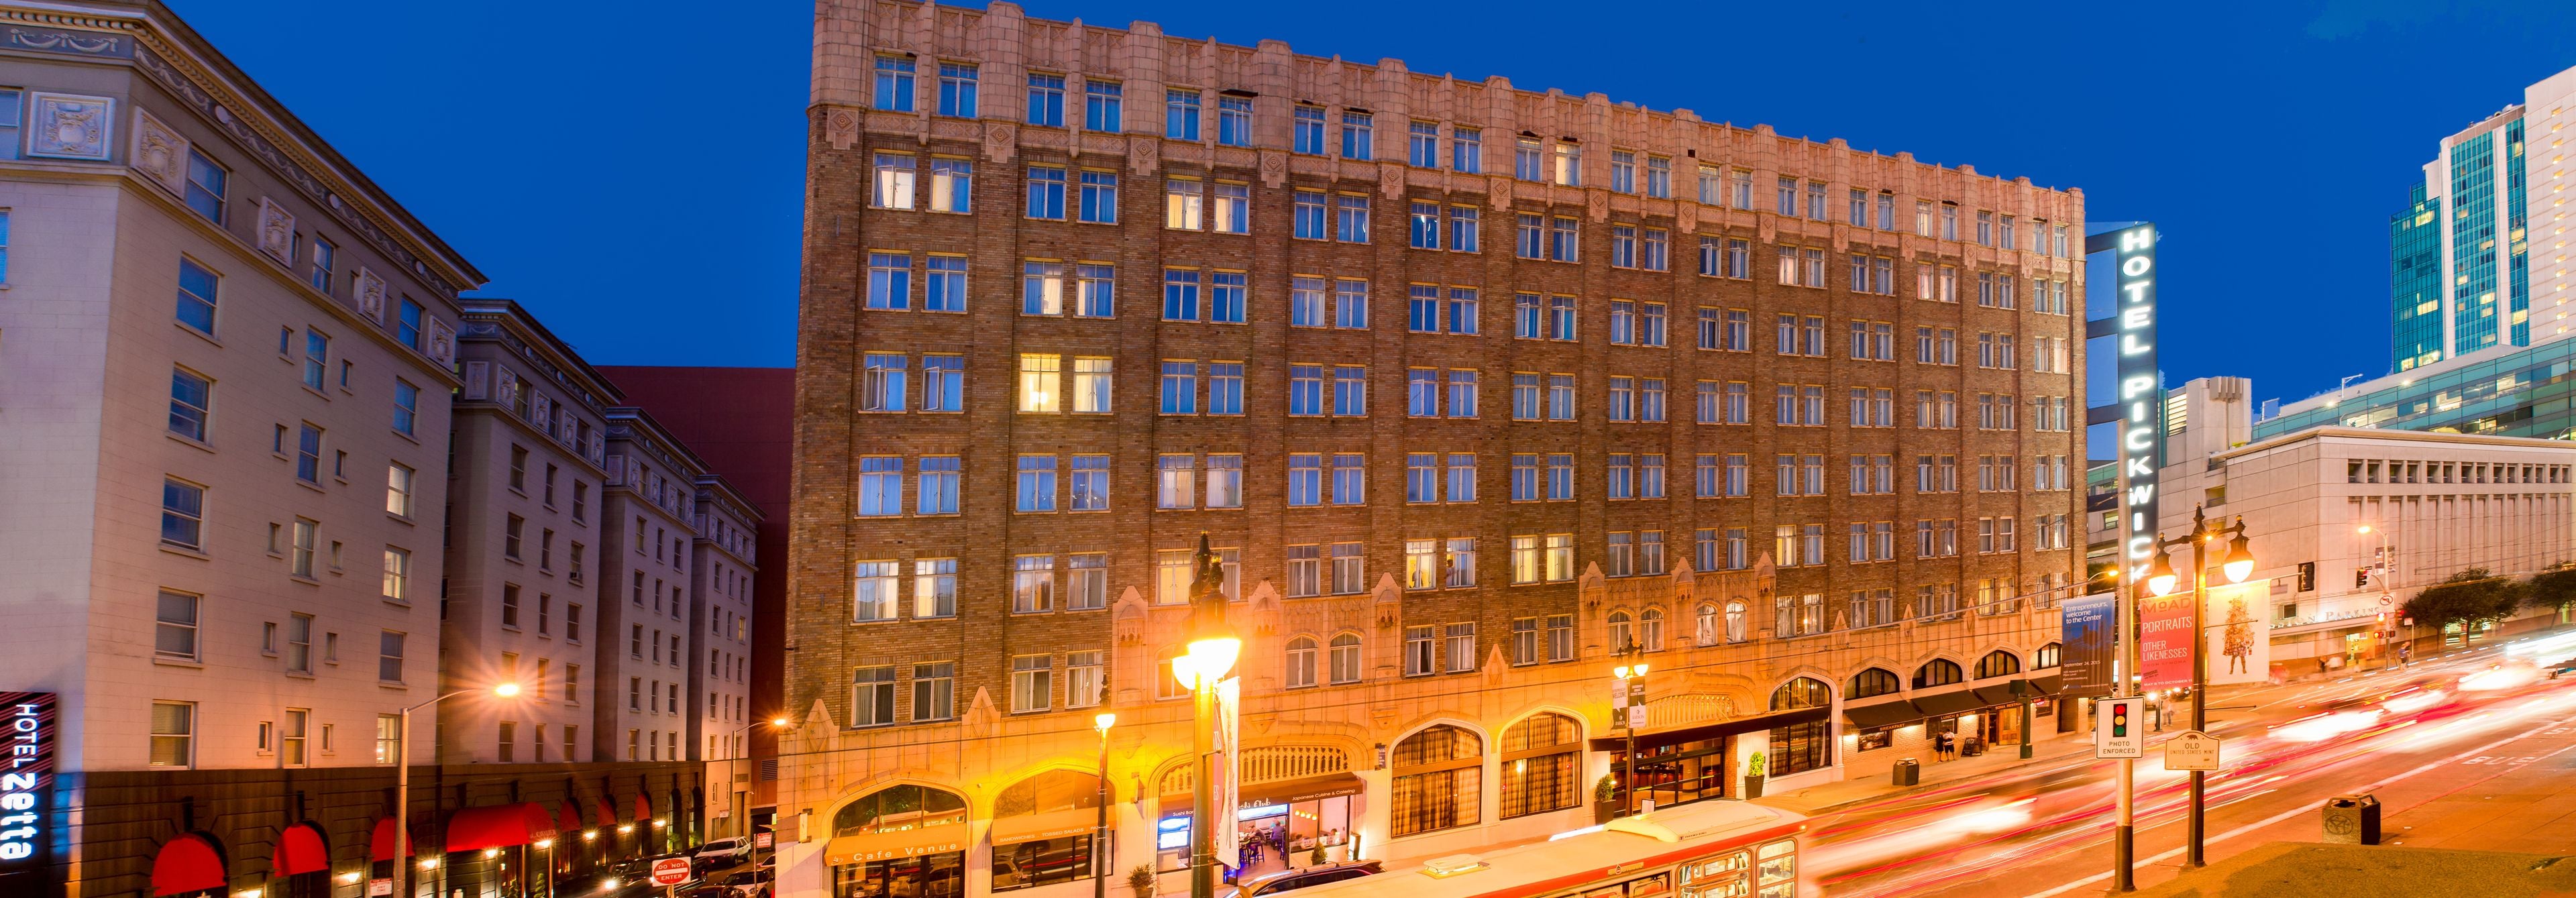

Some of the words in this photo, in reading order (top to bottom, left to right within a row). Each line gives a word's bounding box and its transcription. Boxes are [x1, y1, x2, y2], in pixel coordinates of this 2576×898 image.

[2123, 229, 2151, 355] HOTEL
[2125, 376, 2154, 584] PICKWICK
[2066, 610, 2091, 618] welcome
[2143, 616, 2192, 633] PORTRAITS
[2143, 640, 2167, 652] OTHER
[2143, 647, 2188, 661] LIKENESSES
[13, 704, 38, 768] HOTEL
[2461, 756, 2536, 765] BUS
[1, 773, 38, 860] zetta
[853, 851, 892, 861] Cafe
[905, 844, 957, 856] Venue
